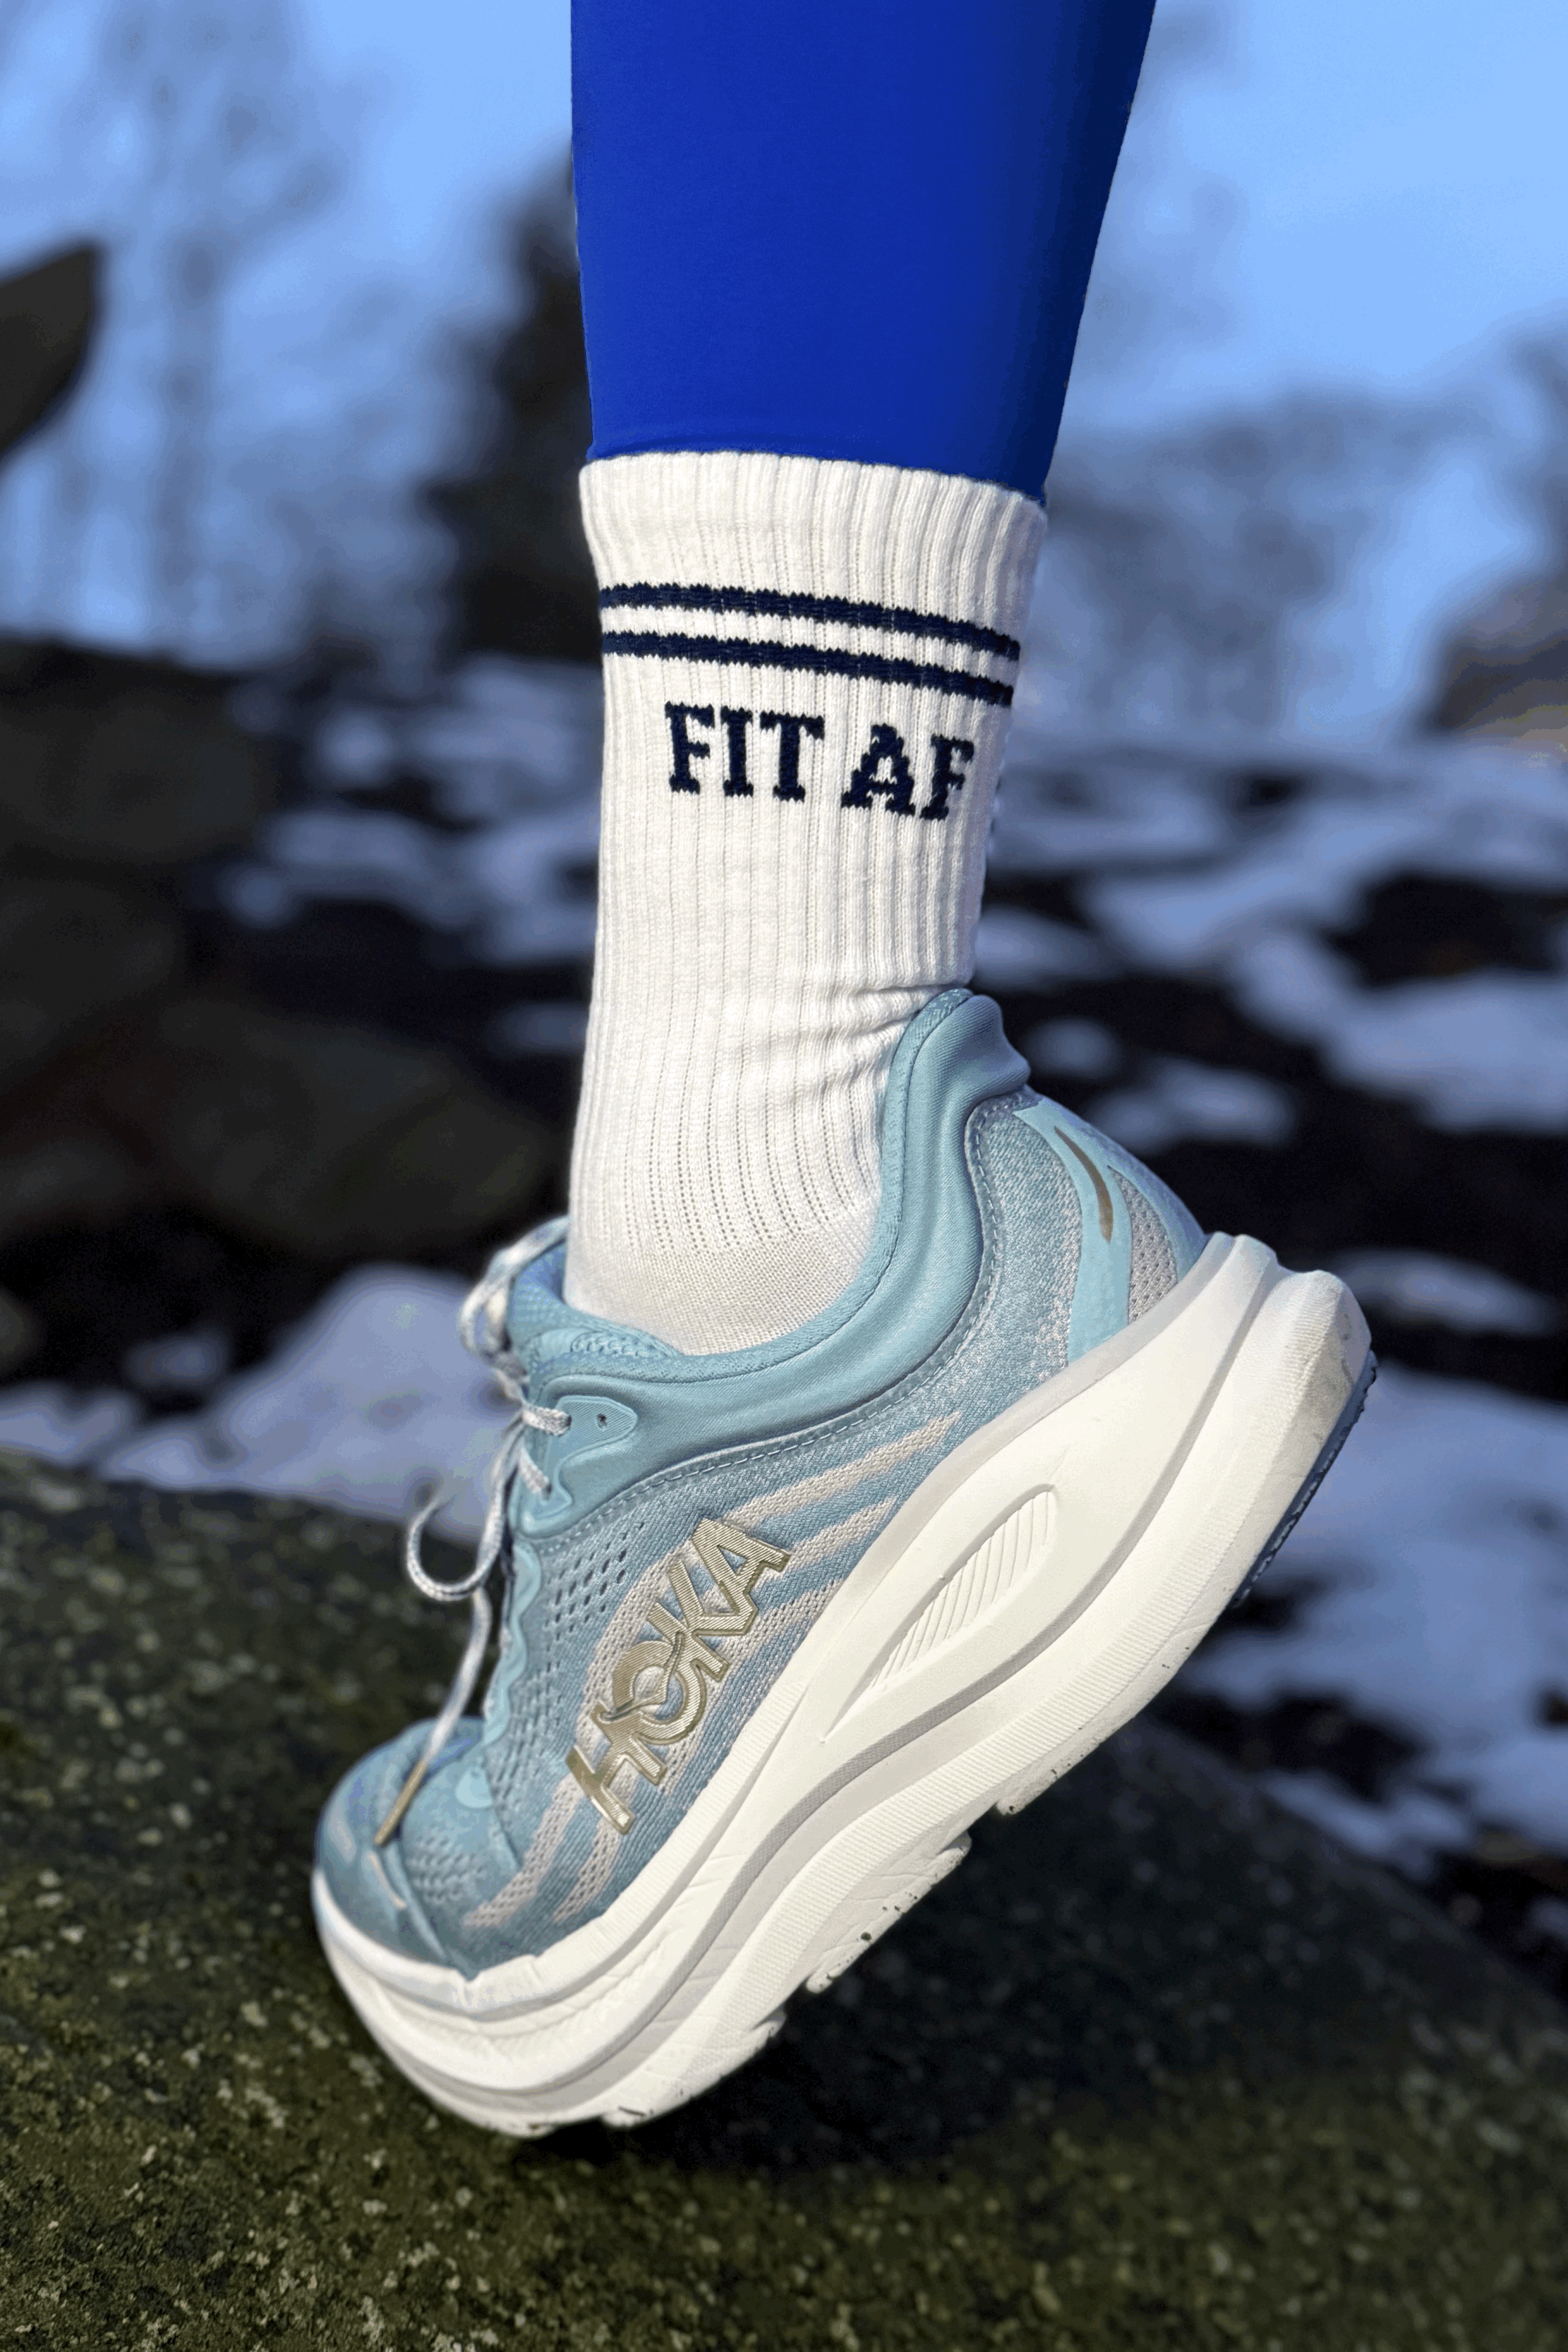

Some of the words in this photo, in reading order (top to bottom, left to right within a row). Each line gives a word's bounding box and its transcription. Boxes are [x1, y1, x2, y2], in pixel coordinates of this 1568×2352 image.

[665, 701, 824, 802] FIT
[840, 723, 975, 821] AF
[566, 1518, 791, 1835] HOKA
